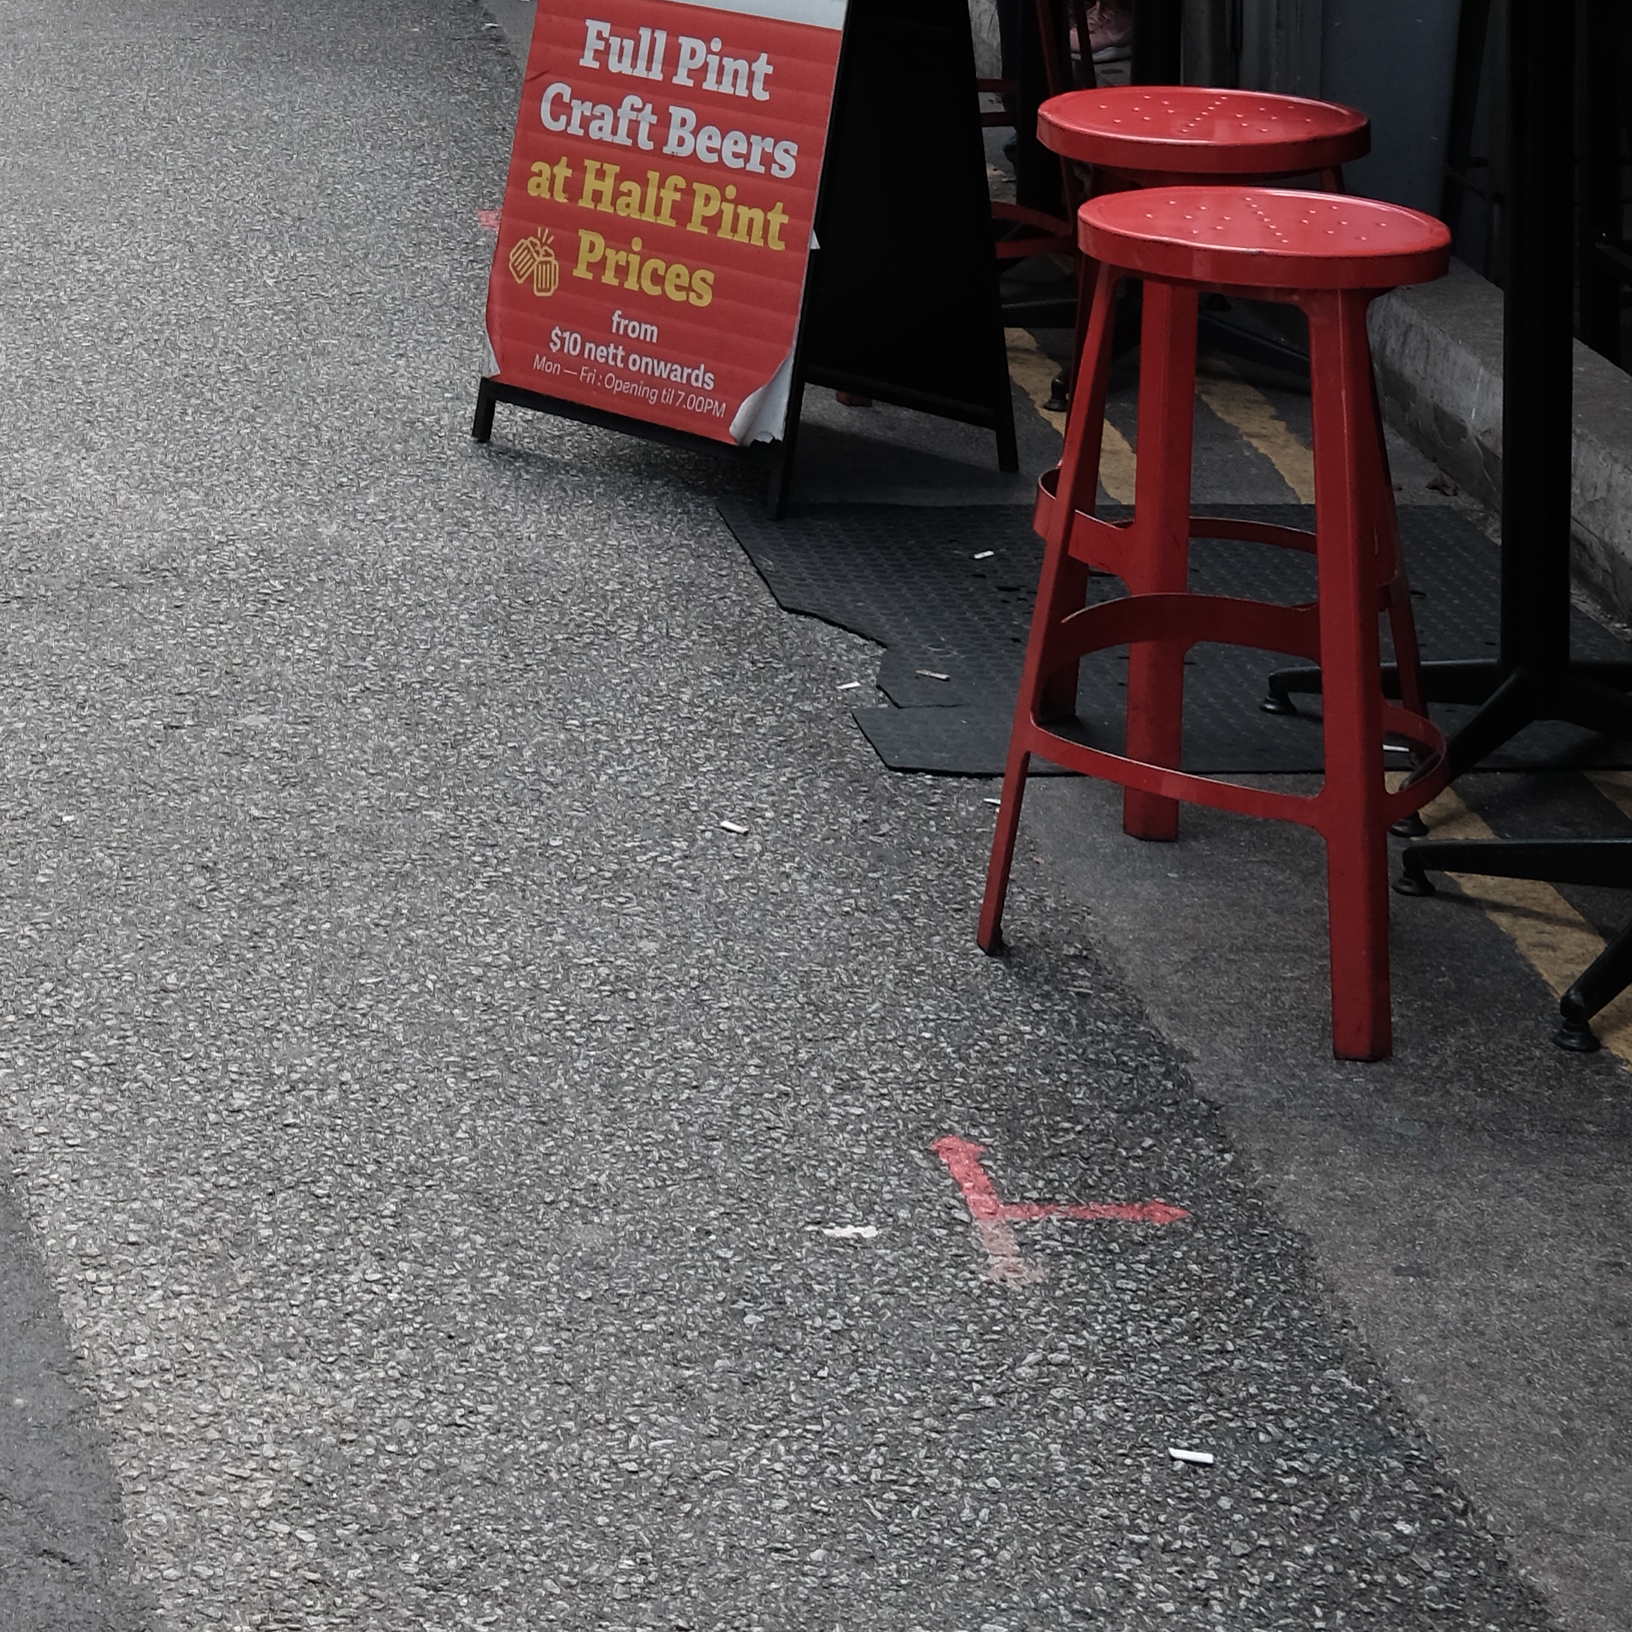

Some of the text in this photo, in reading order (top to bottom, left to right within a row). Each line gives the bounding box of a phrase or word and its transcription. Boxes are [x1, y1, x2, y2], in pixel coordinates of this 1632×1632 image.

[578, 17, 774, 102] Full Pint
[539, 82, 799, 180] Craft Beers
[526, 155, 790, 252] at Half Pint
[572, 228, 716, 308] Prices
[548, 326, 715, 392] $10 nett onwards
[610, 309, 659, 344] from
[532, 352, 561, 375] Mon
[603, 367, 659, 405] Opening
[660, 383, 674, 403] til
[675, 388, 727, 419] 7.00PM
